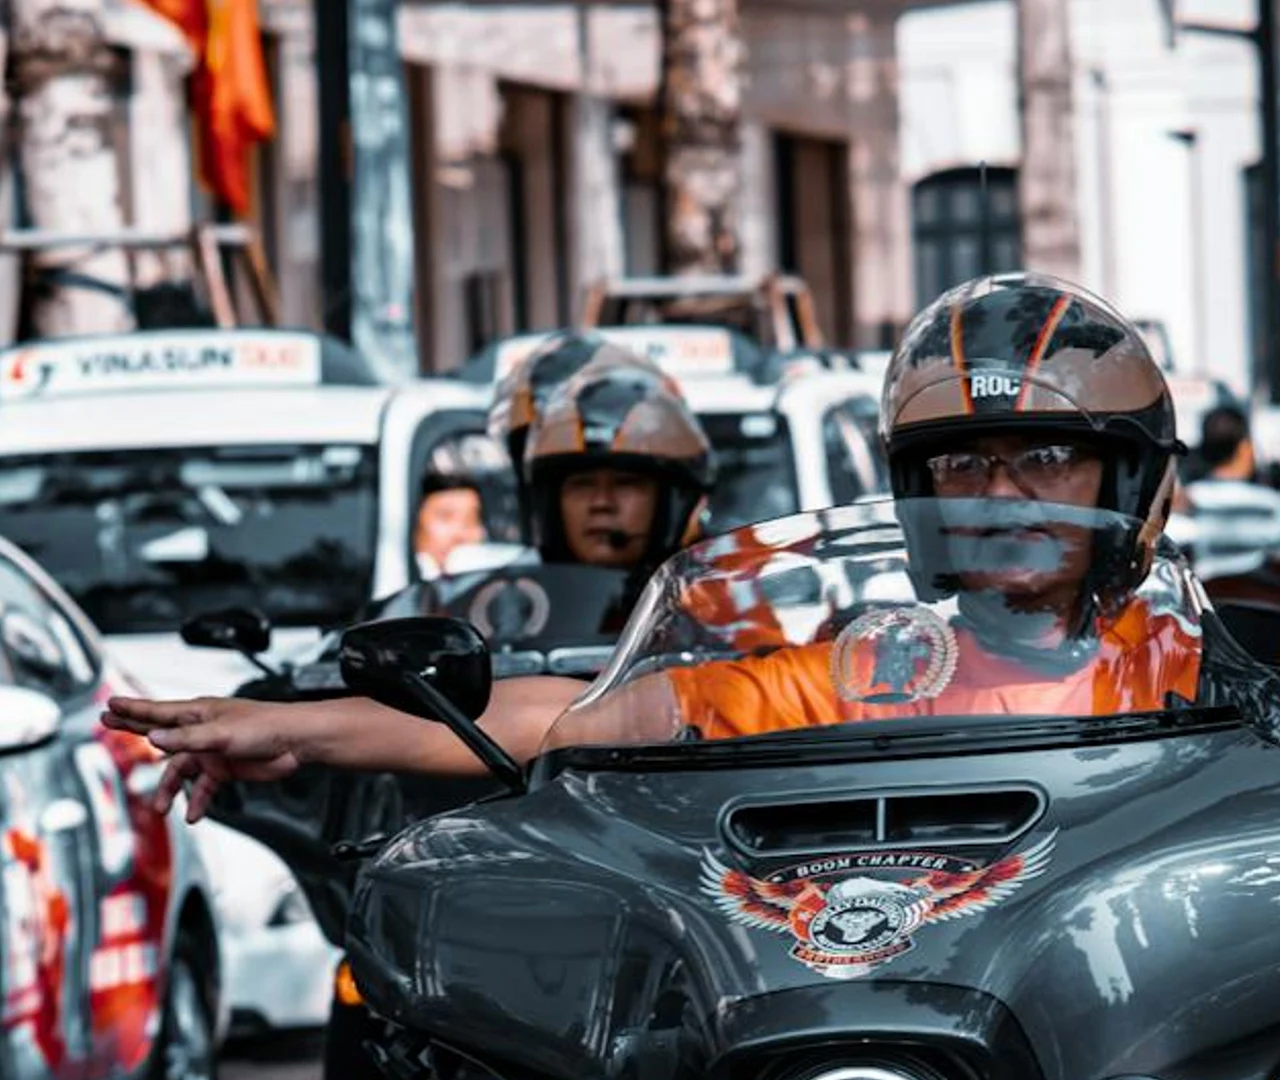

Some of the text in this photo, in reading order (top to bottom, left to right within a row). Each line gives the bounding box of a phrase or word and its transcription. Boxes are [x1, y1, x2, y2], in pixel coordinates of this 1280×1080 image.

[971, 374, 1020, 398] ROC
[796, 854, 948, 877] BOOM CHAPTER
